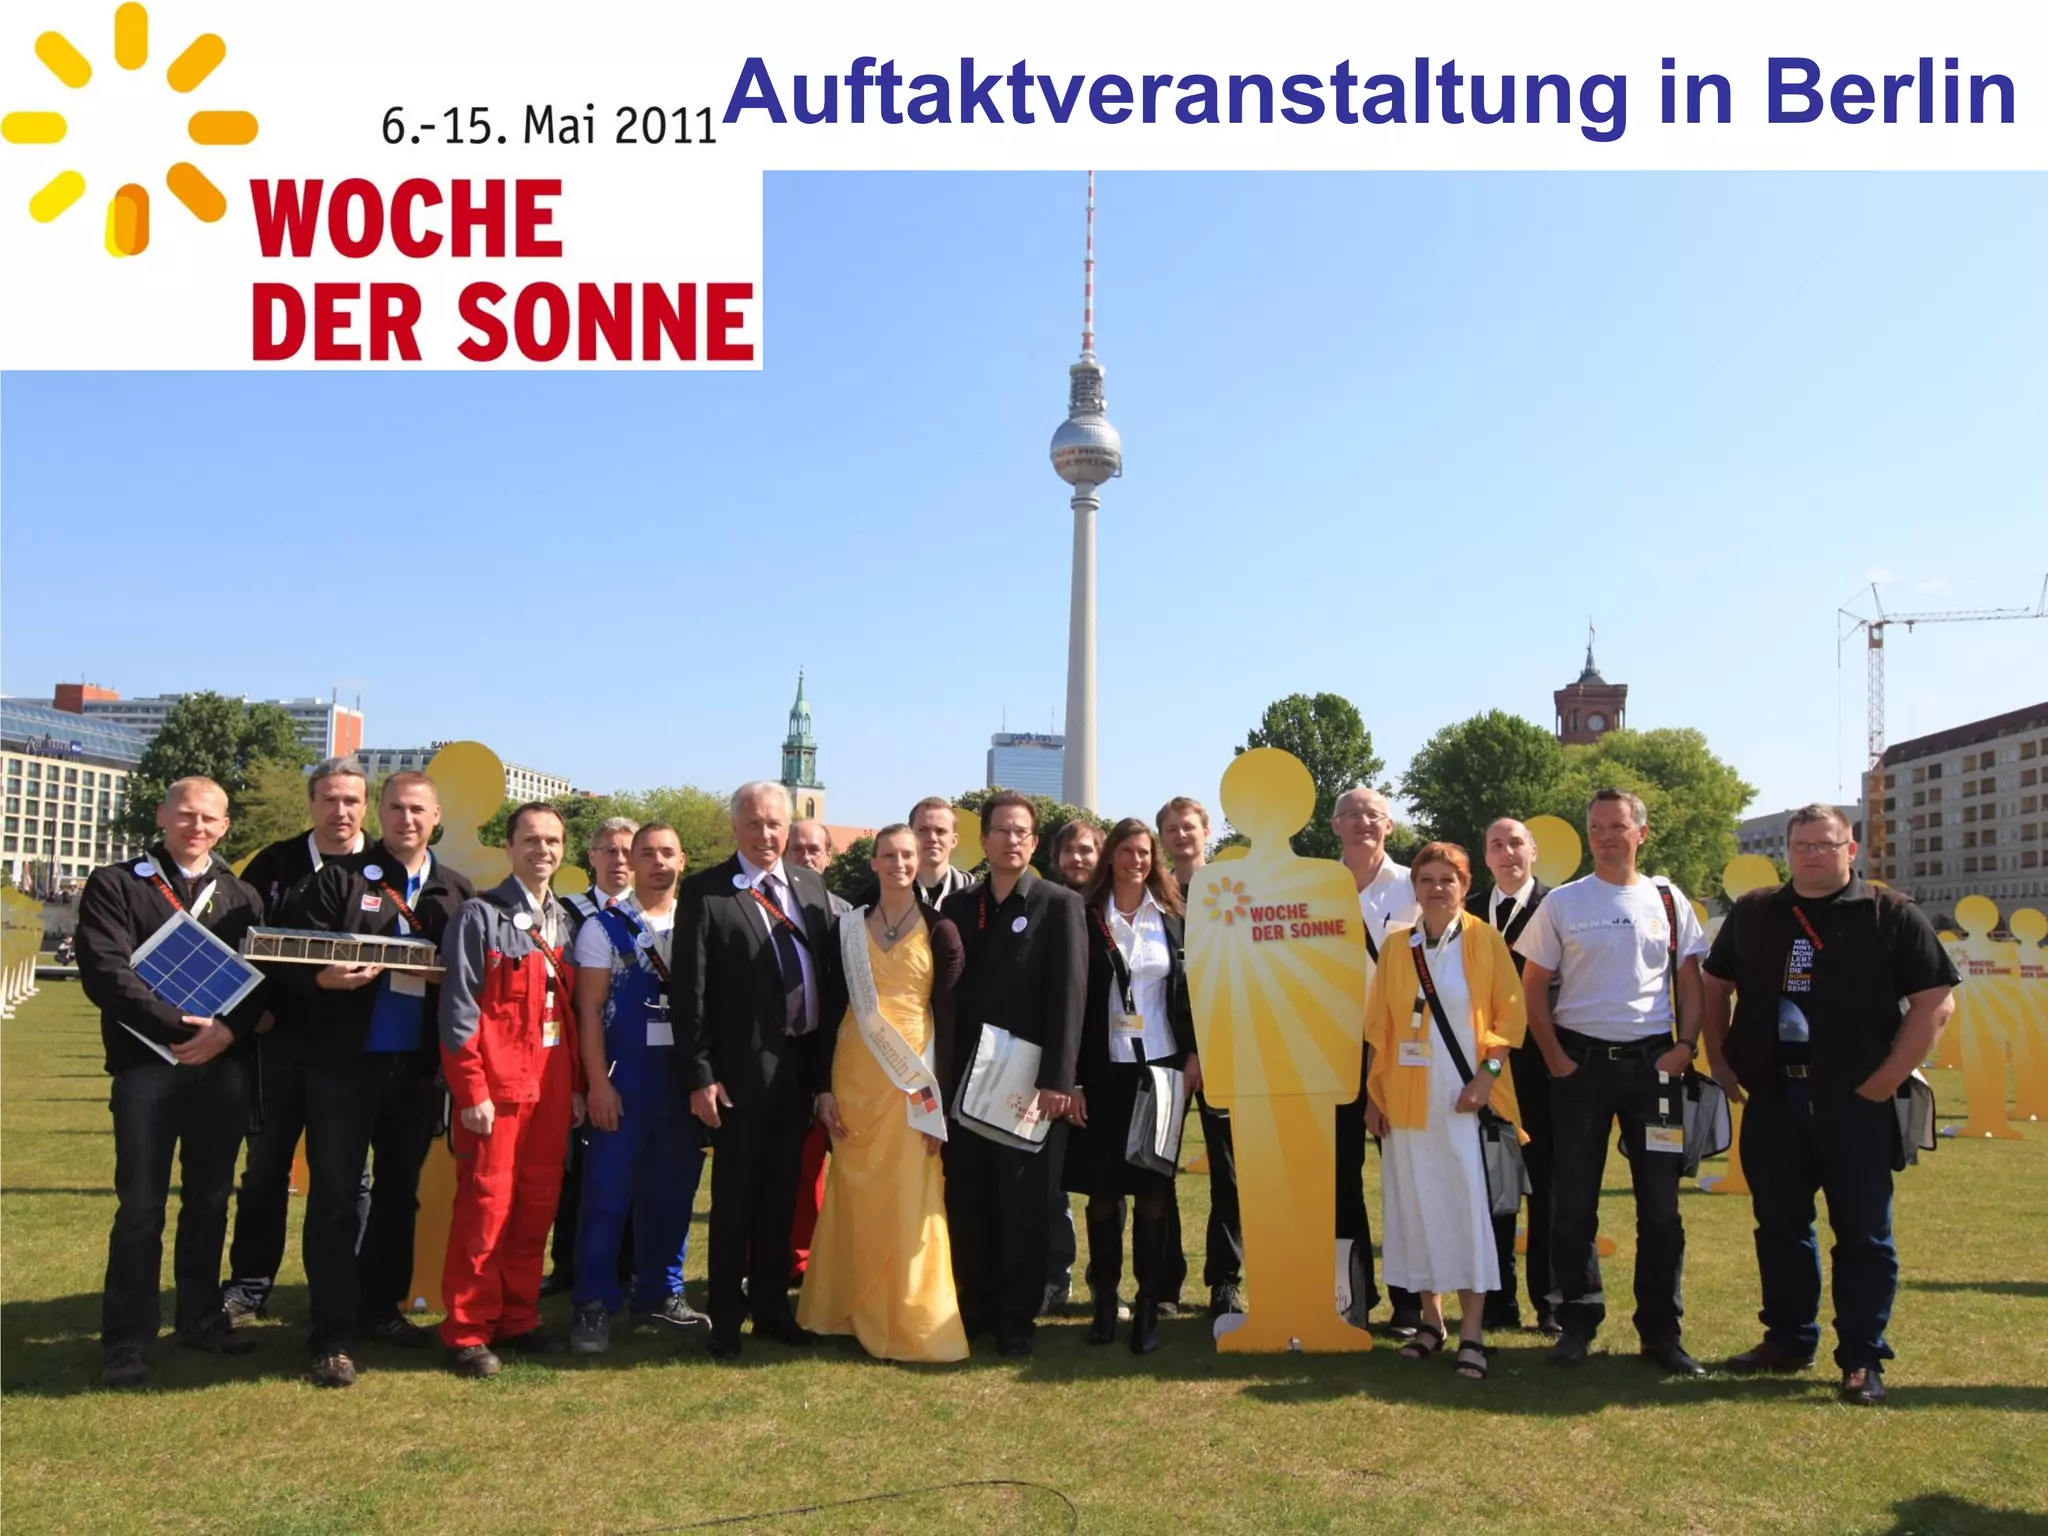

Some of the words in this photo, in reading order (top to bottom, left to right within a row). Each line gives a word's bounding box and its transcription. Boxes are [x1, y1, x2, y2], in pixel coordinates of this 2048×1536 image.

[1250, 903, 1309, 922] WOCHE
[1252, 924, 1285, 942] DER
[1290, 919, 1346, 938] SONNE
[868, 1026, 910, 1078] Jasmin
